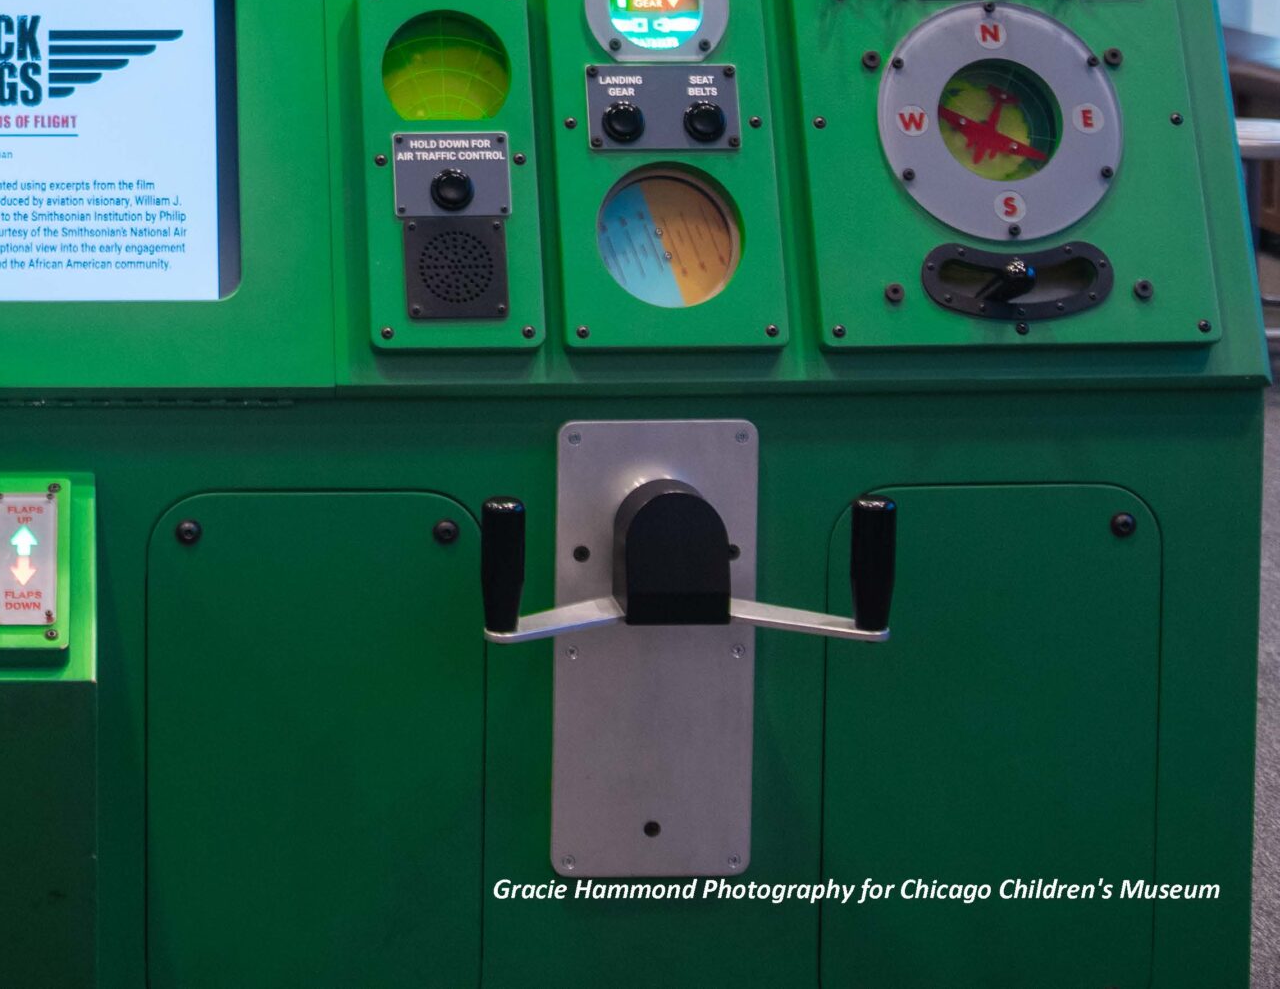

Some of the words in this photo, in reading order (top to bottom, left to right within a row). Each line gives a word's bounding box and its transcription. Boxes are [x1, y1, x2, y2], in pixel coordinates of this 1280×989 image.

[980, 24, 1000, 42] N
[599, 75, 643, 85] LANDING
[688, 75, 715, 85] SEAT
[608, 87, 635, 97] GEAR
[687, 87, 718, 96] BELTS
[15, 114, 31, 129] OF
[34, 114, 78, 129] FLIGHT
[898, 113, 926, 131] W
[1081, 109, 1094, 128] E
[409, 139, 437, 149] HOLD
[439, 139, 469, 149] DOWN
[471, 139, 491, 148] FOR
[397, 152, 414, 161] AIR
[415, 151, 456, 161] TRAFFIC
[458, 151, 505, 160] CONTROL
[20, 180, 46, 192] using
[49, 181, 91, 191] excerpts
[93, 179, 115, 190] from
[118, 179, 133, 191] the
[136, 179, 155, 190] film
[32, 195, 43, 208] by
[46, 196, 84, 206] aviation
[87, 195, 133, 208] visionary,
[135, 195, 170, 206] William
[172, 195, 182, 206] J.
[1003, 197, 1018, 217] S
[1, 212, 11, 222] to
[13, 211, 28, 222] the
[31, 211, 91, 222] Smithsonian
[94, 211, 143, 222] Institution
[145, 211, 157, 224] by
[159, 210, 186, 223] Philip
[31, 226, 41, 237] of
[43, 226, 59, 237] the
[61, 227, 127, 237] Smithsonian's
[130, 227, 171, 237] National
[173, 227, 186, 237] Air
[36, 243, 57, 253] view
[60, 243, 78, 253] into
[81, 242, 97, 253] the
[99, 242, 122, 255] early
[125, 243, 186, 255] engagement
[10, 258, 25, 269] the
[28, 257, 63, 269] African
[65, 259, 112, 269] American
[115, 259, 171, 271] community.
[7, 506, 44, 515] FLAPS
[17, 516, 33, 524] UP
[4, 591, 43, 600] FLAPS
[5, 602, 41, 611] DOWN
